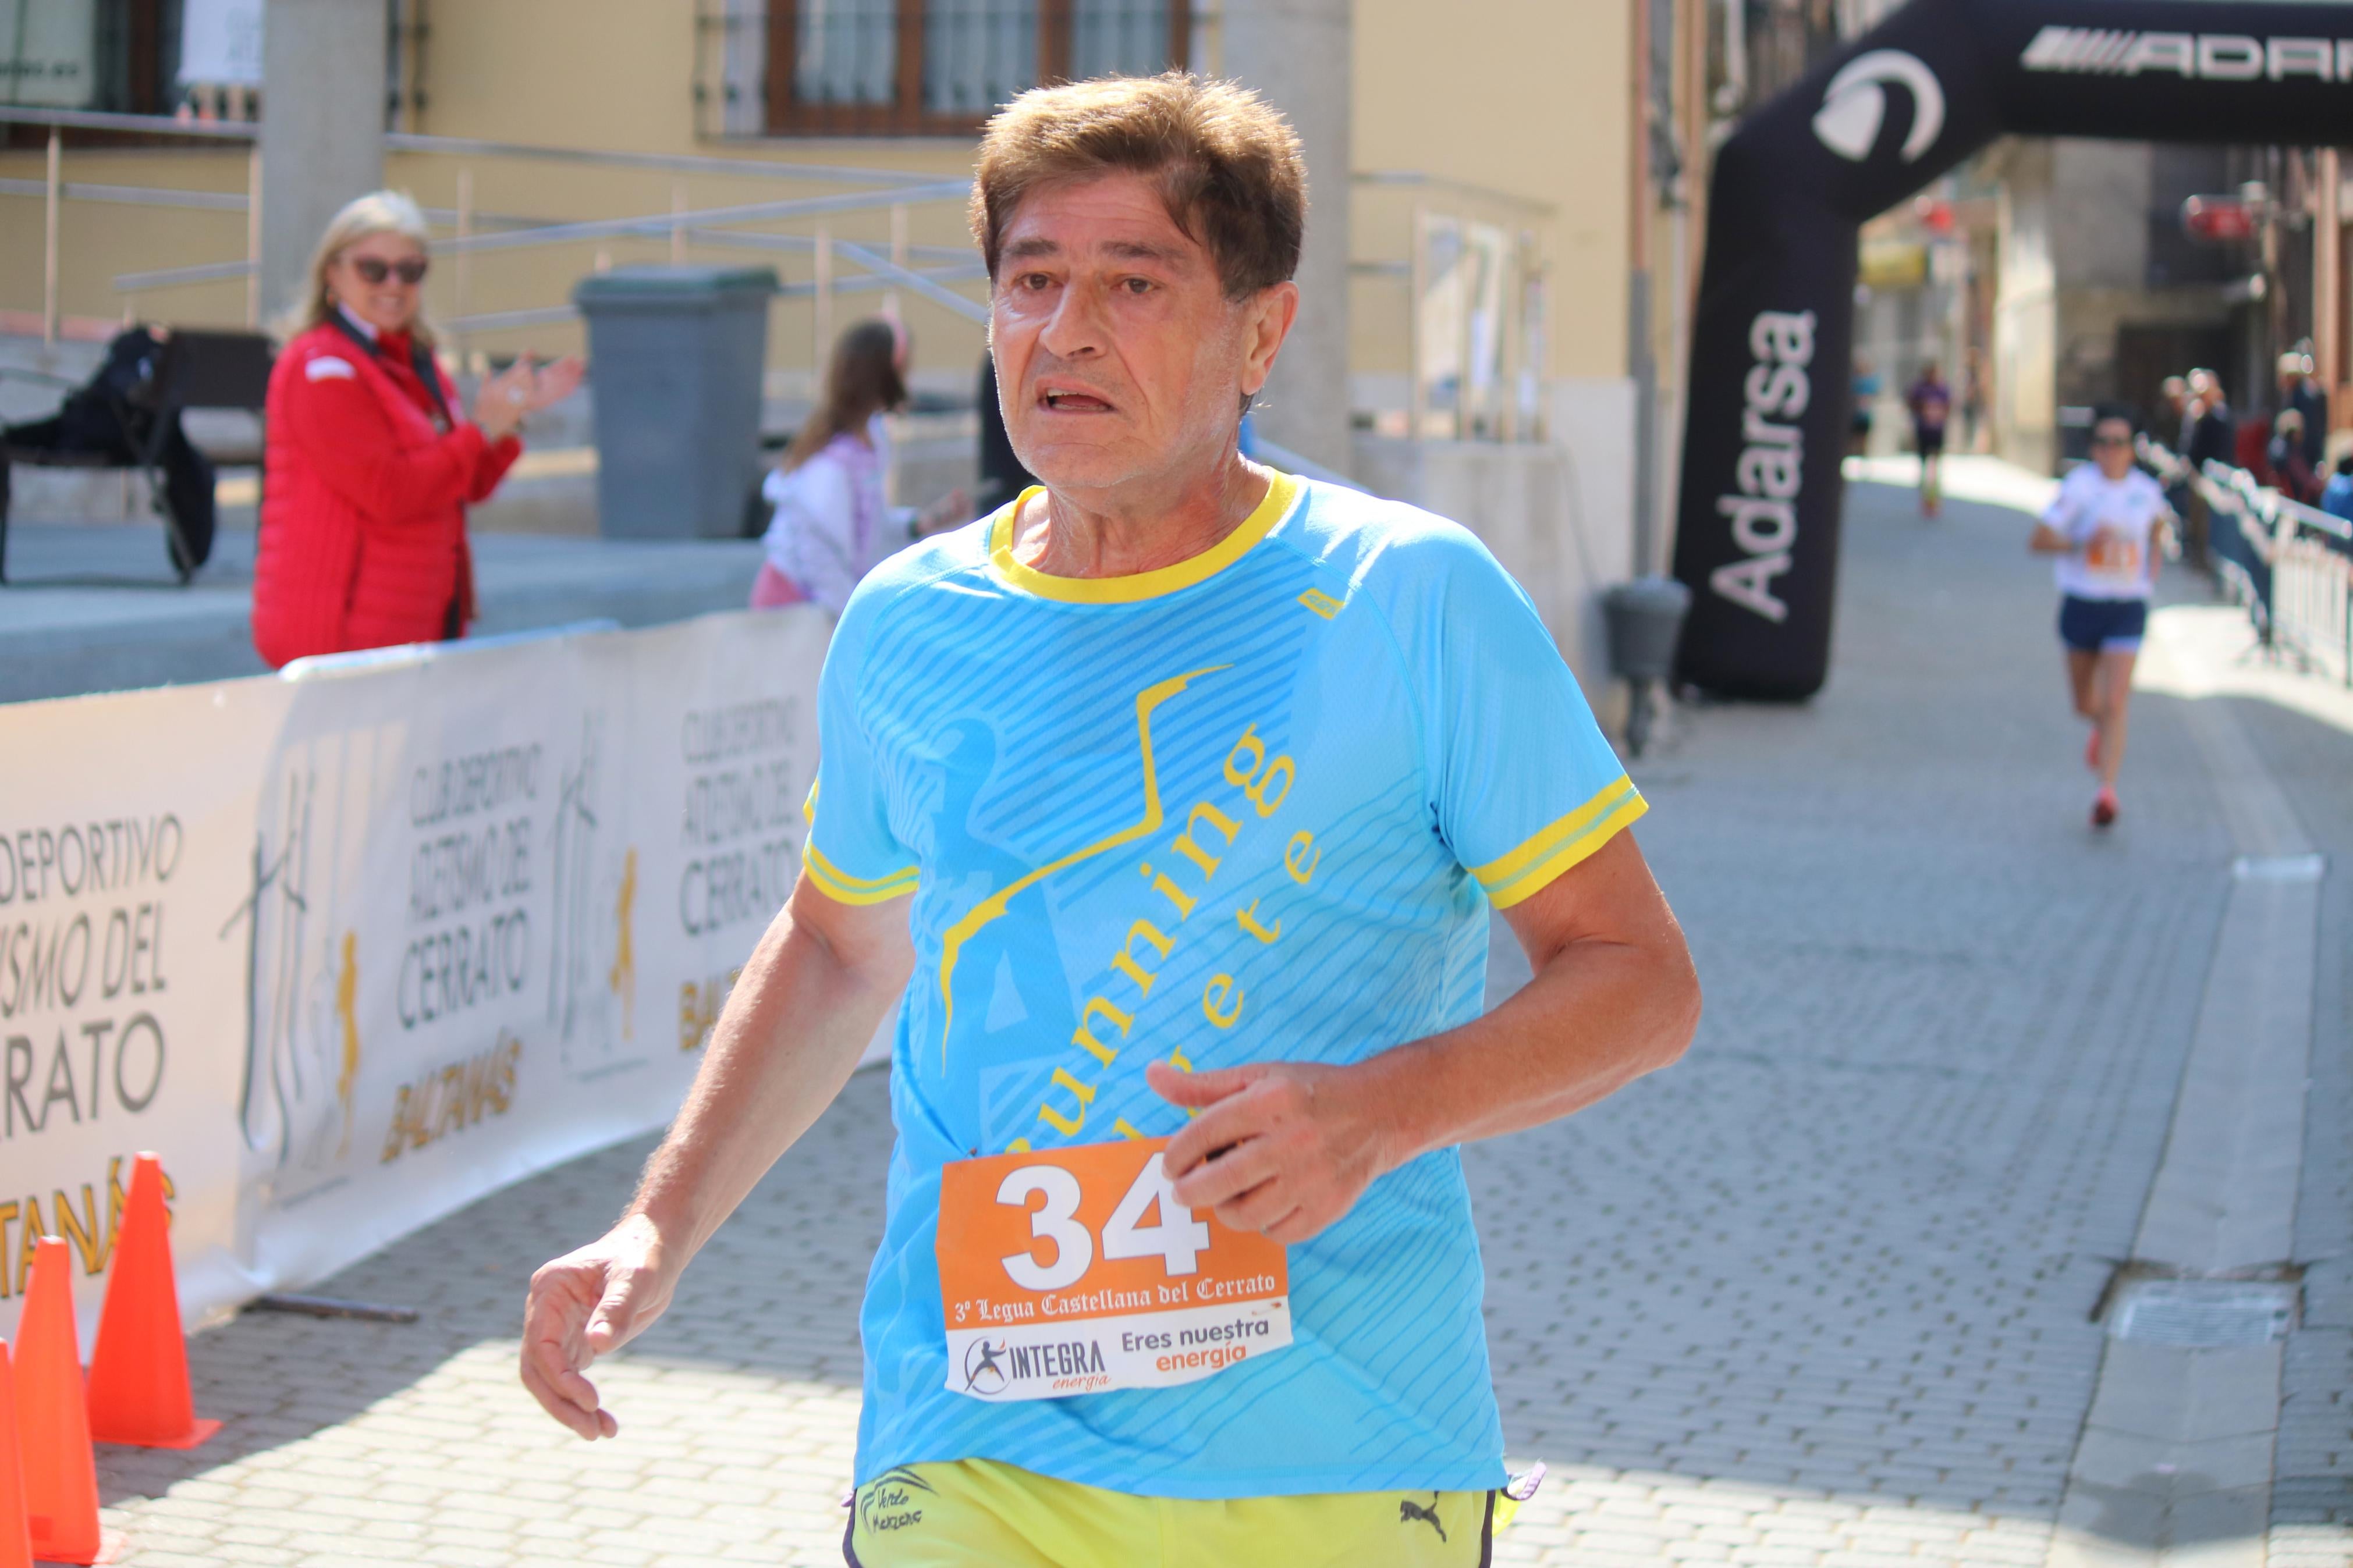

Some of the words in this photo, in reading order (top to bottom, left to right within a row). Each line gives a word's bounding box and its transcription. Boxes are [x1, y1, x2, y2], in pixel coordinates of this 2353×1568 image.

[1709, 310, 1818, 624] Adarsa
[101, 902, 167, 1001] DEL
[397, 906, 531, 1032] CERRATO
[0, 1010, 165, 1139] RATO
[996, 1151, 1210, 1291] 34
[975, 1298, 1035, 1324] Legua
[1041, 1288, 1151, 1316] Castellana
[1158, 1281, 1189, 1304] del
[1197, 1274, 1276, 1300] Cerrato
[1122, 1332, 1172, 1352] Eres
[1180, 1318, 1269, 1346] nuestra
[1009, 1339, 1106, 1379] INTEGRA
[1156, 1341, 1247, 1371] energía
